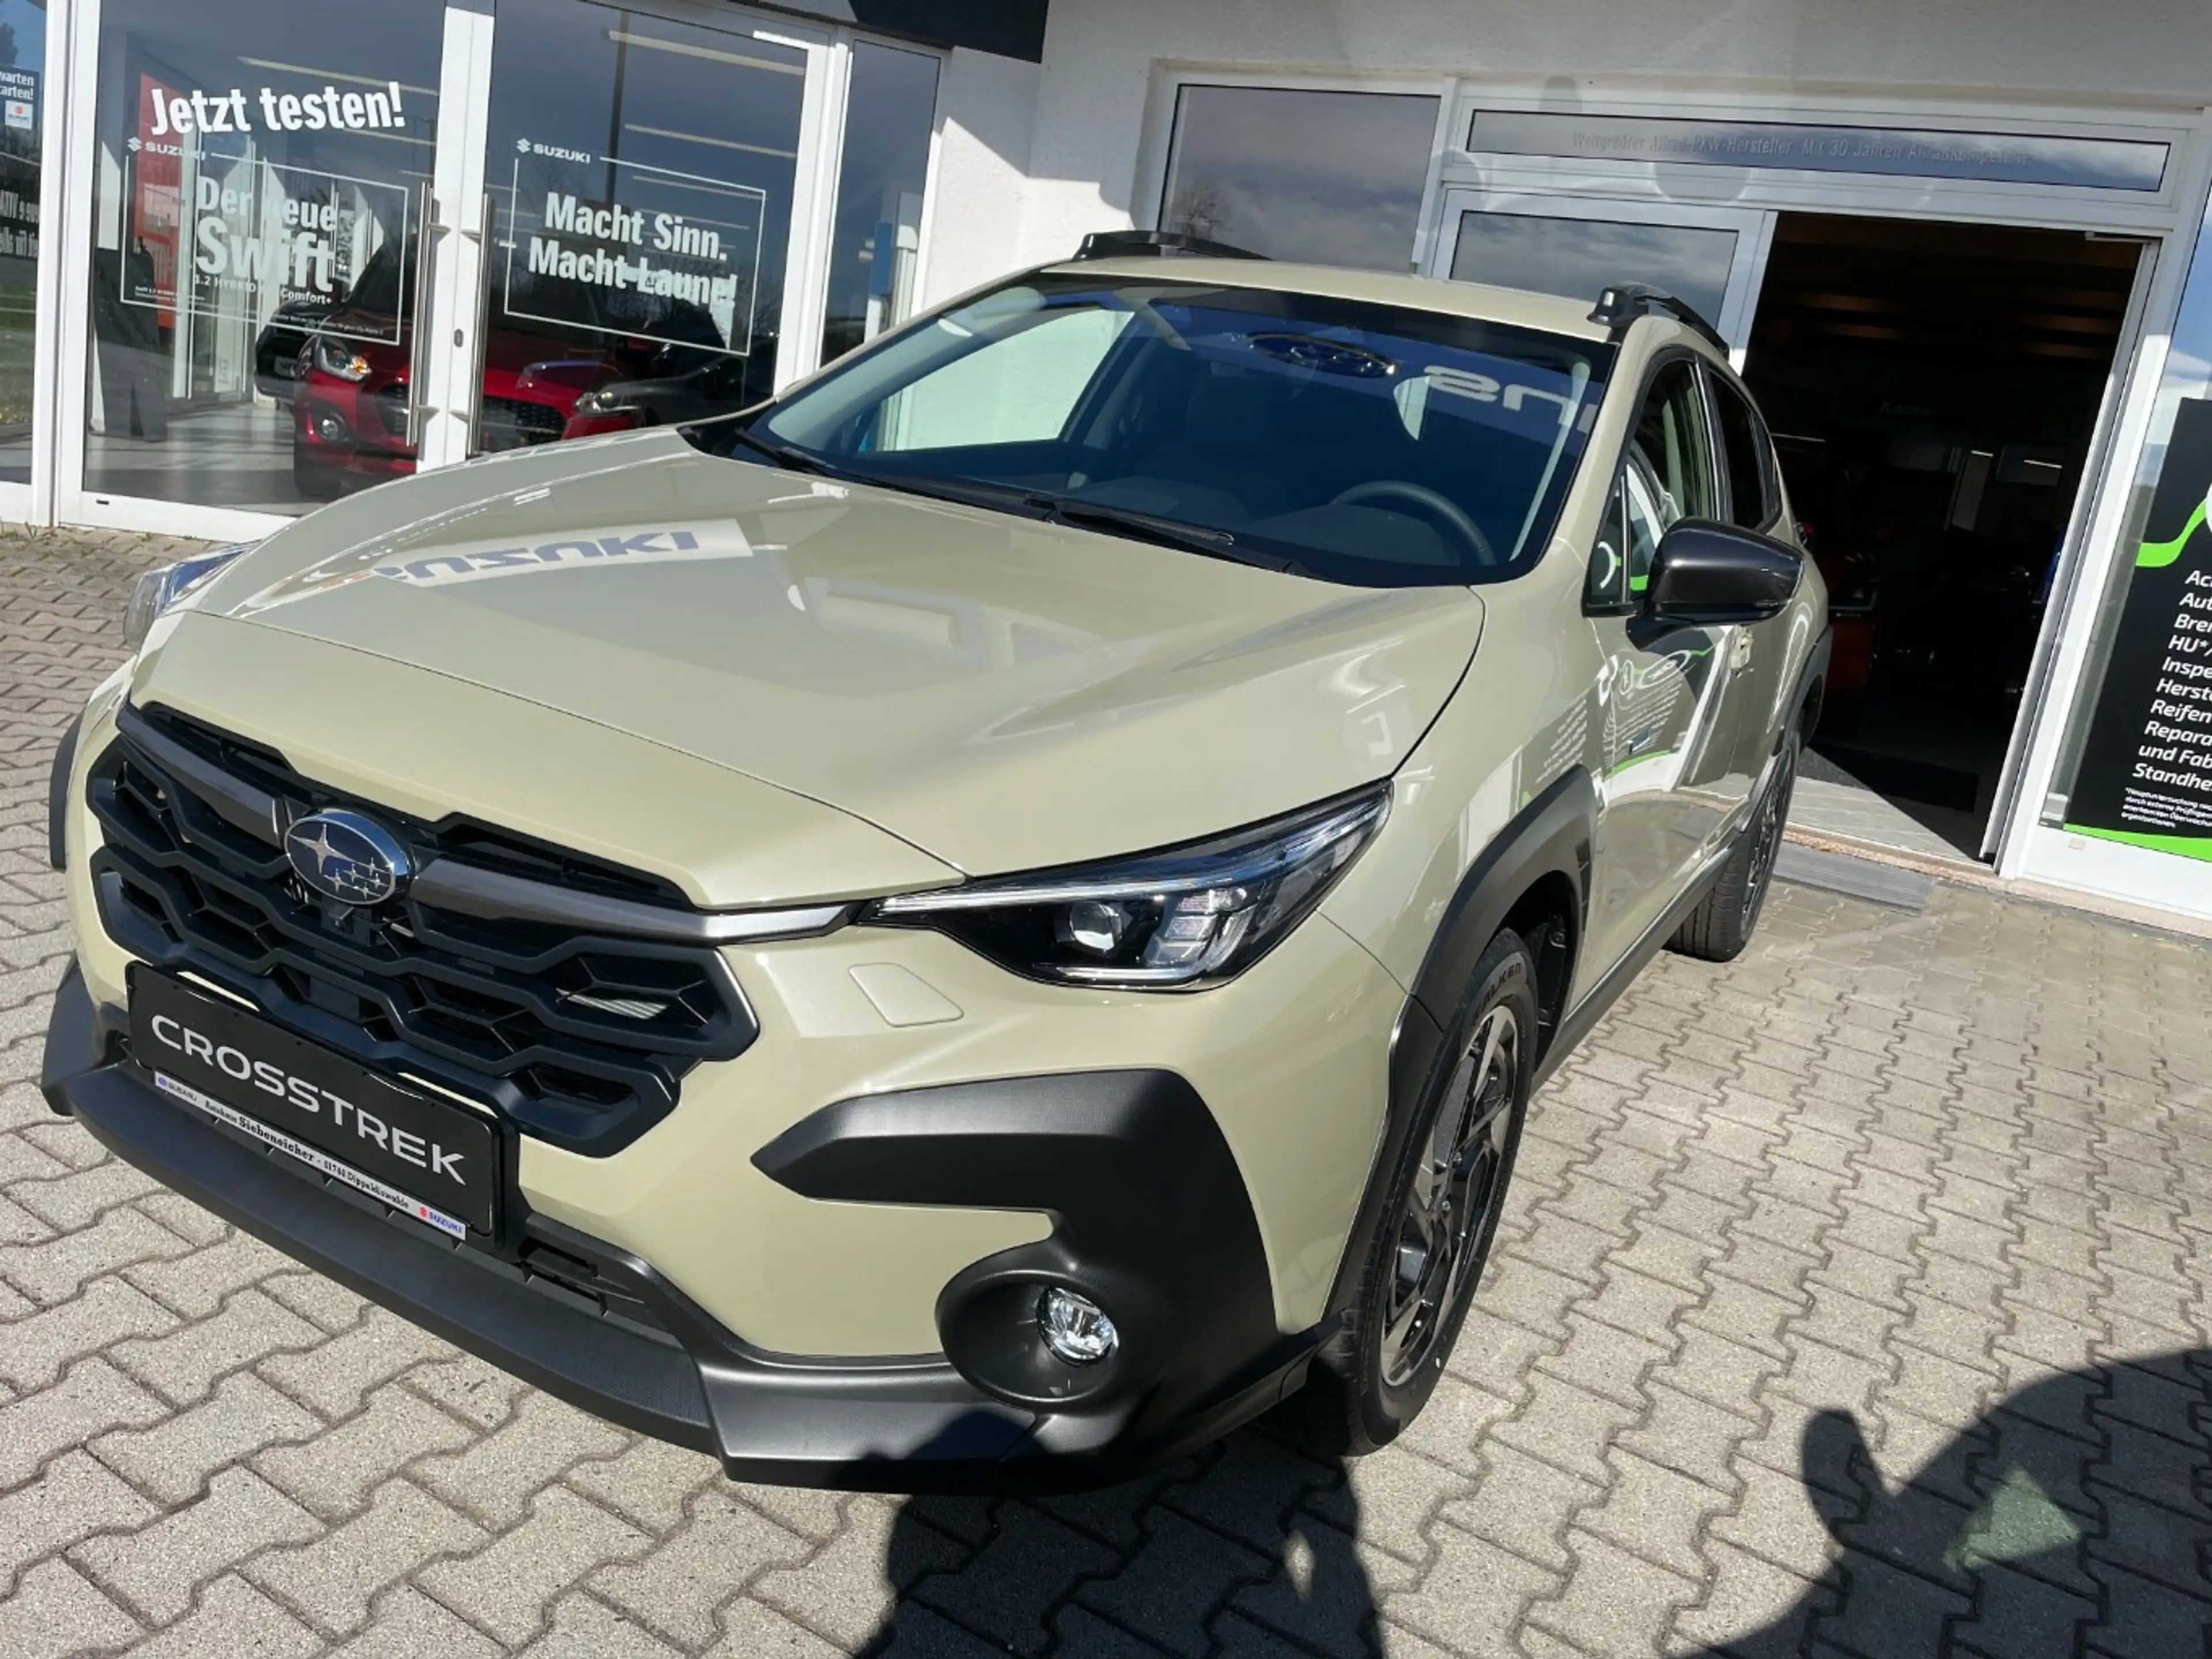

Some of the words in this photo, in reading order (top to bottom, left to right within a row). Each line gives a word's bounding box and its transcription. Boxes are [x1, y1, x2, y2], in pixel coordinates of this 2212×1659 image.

[0, 86, 33, 100] arten!
[151, 88, 252, 135] Jetzt
[259, 81, 406, 131] testen!
[533, 143, 591, 164] SUZUKI
[198, 176, 253, 217] Der
[545, 191, 645, 245] Macht
[653, 213, 728, 261] Sinn.
[196, 216, 334, 293] Swift
[528, 236, 628, 289] Macht
[2184, 570, 2212, 588] Ac
[2150, 699, 2212, 724] Reifen
[2144, 720, 2212, 747] Repara
[2138, 745, 2178, 762] und
[2178, 749, 2212, 769] Fab
[2132, 763, 2212, 791] Standhe
[151, 1015, 466, 1185] CROSSTREK
[429, 1211, 462, 1234] SUZUKI
